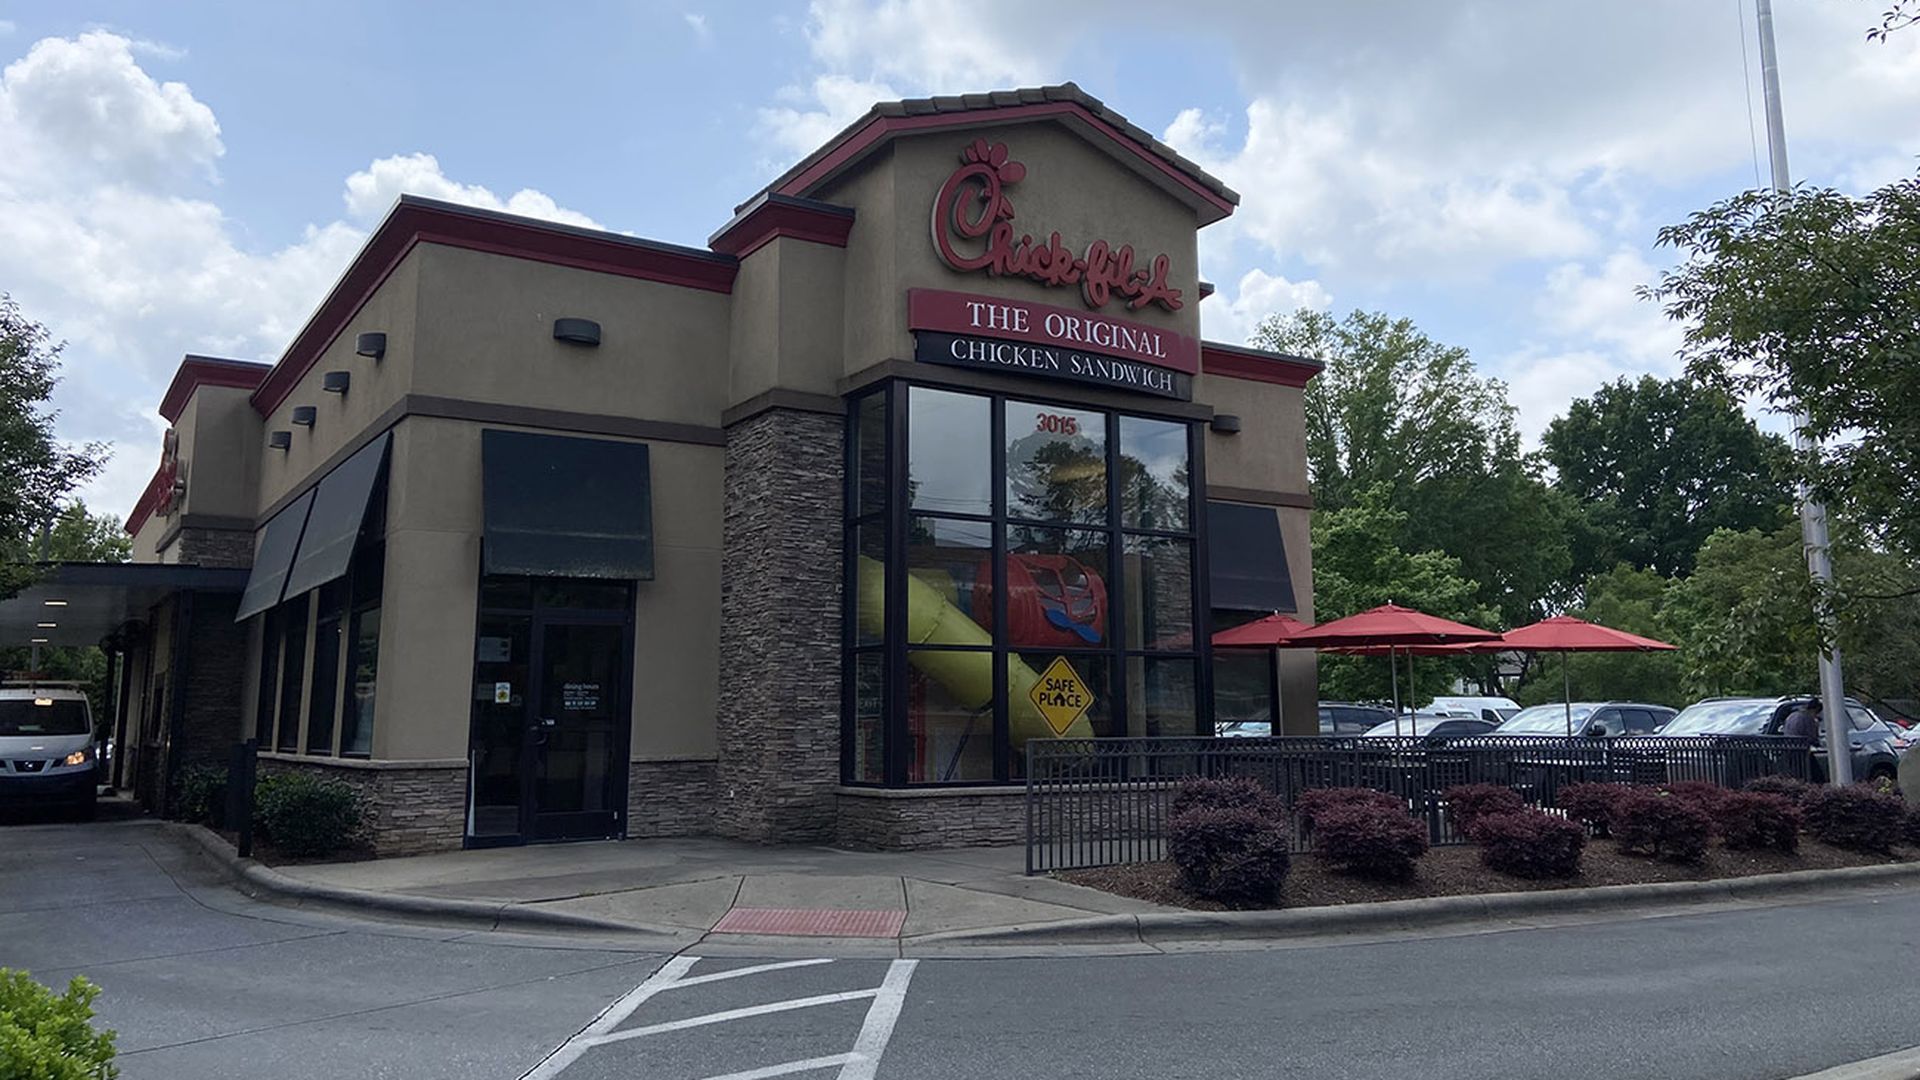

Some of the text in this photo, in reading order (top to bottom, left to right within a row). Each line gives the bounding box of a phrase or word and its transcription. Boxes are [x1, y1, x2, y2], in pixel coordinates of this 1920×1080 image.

[931, 138, 1184, 312] Chick-fil-A
[967, 302, 1167, 358] THE ORIGINAL
[951, 339, 1172, 392] CHICKEN SANDWICH
[1036, 412, 1077, 436] 3015
[1045, 678, 1074, 692] SAFE
